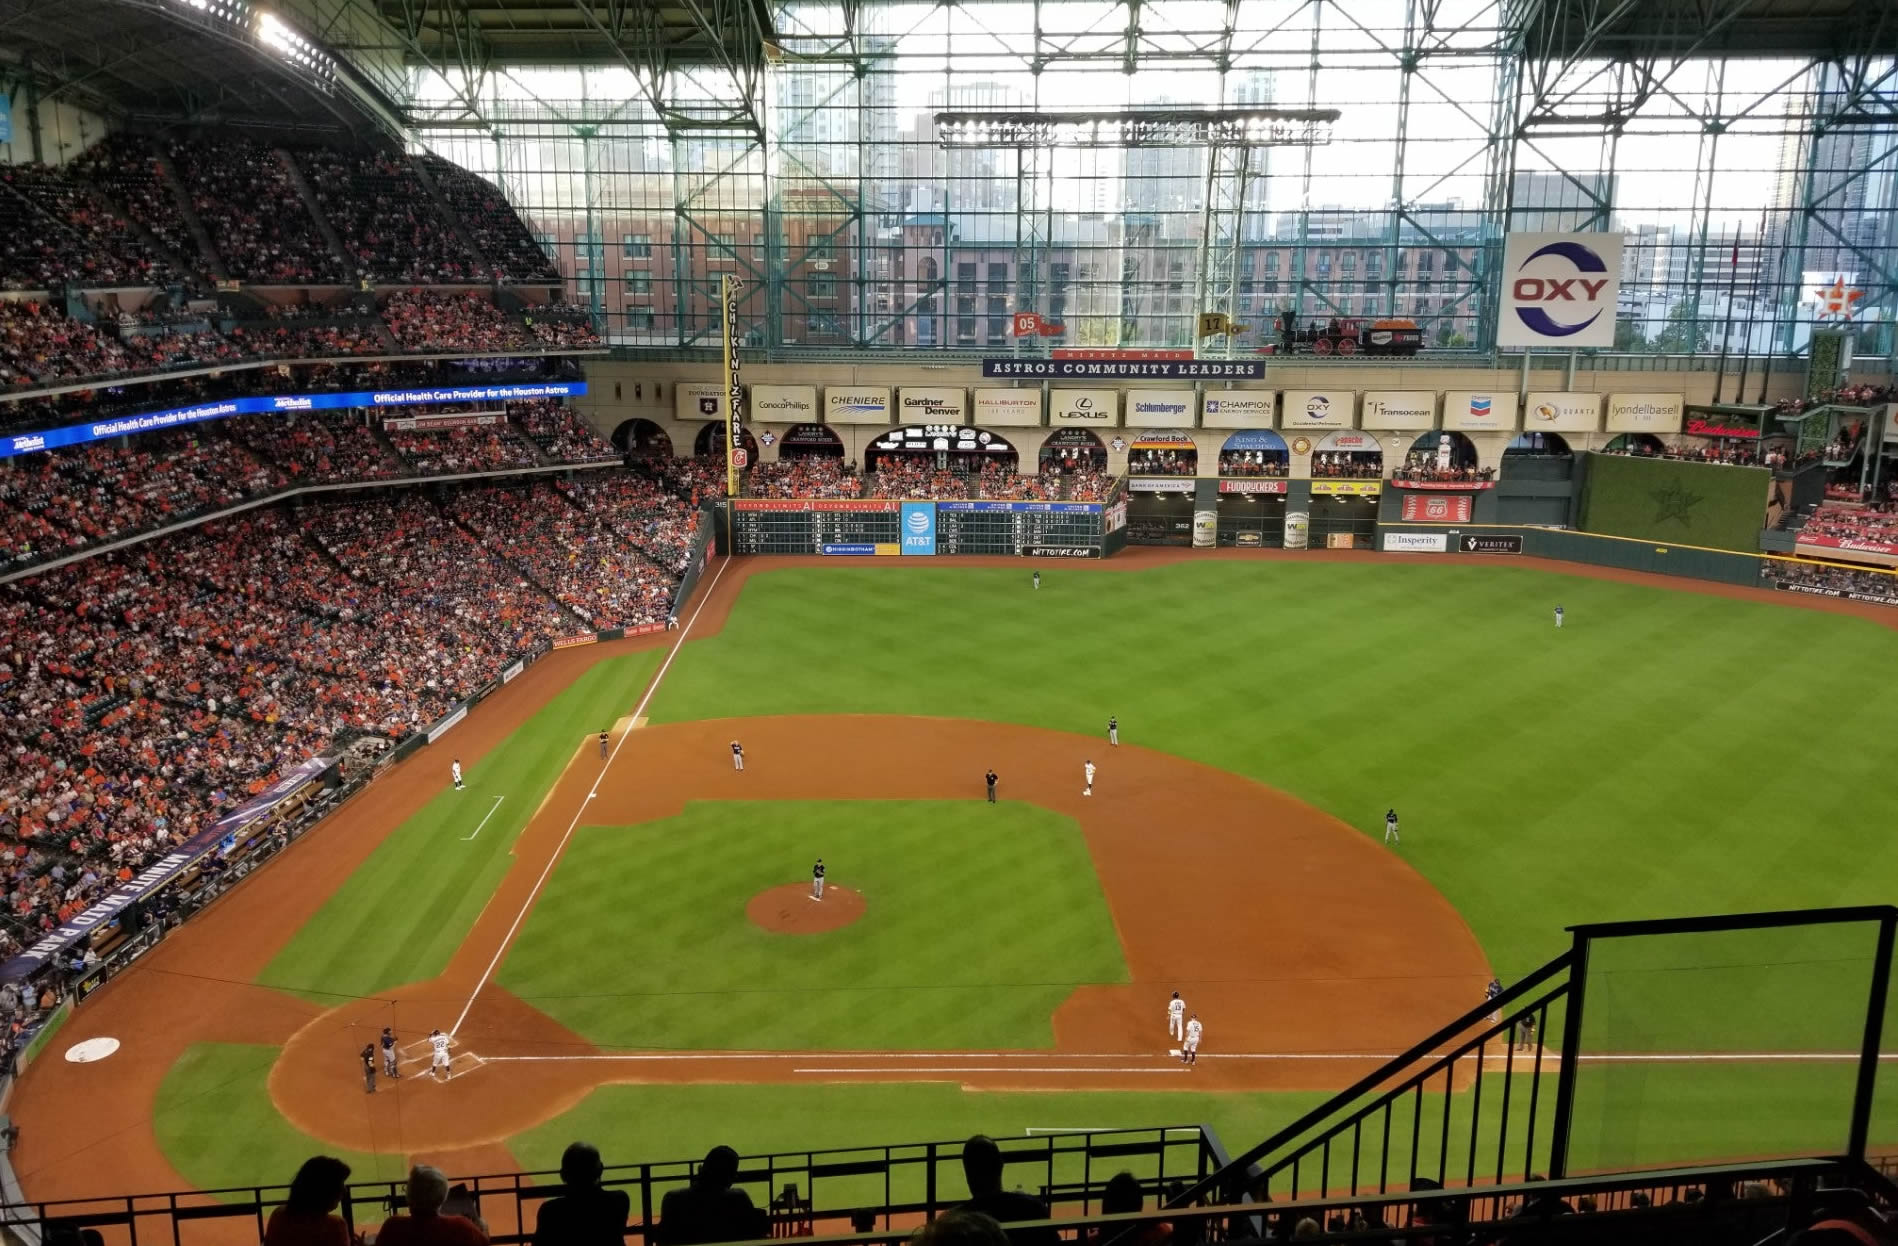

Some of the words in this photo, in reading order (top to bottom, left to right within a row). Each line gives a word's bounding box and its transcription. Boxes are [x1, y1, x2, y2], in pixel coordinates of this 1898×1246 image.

[1513, 278, 1609, 301] OXY
[1019, 317, 1035, 330] 05
[1205, 317, 1220, 331] 17
[730, 303, 740, 370] CHIKIN
[993, 363, 1055, 374] ASTROS
[1063, 364, 1170, 375] COMMUNITY
[1178, 364, 1255, 375] LEADERS
[731, 372, 741, 397] IZ
[374, 393, 404, 403] Official
[405, 392, 433, 402] Health
[434, 391, 452, 400] Care
[453, 390, 485, 400] Provider
[487, 389, 499, 398] for
[500, 388, 512, 397] the
[513, 387, 544, 397] Houston
[545, 386, 568, 396] Astros
[759, 401, 809, 411] ConocoPhillips
[831, 396, 885, 405] CHENIERE
[904, 397, 944, 406] Gardner
[1220, 400, 1271, 409] CHAMPION
[924, 406, 960, 416] Denver
[1135, 402, 1186, 414] Schlumberger
[1379, 408, 1430, 417] Transocean
[1612, 404, 1679, 417] lyondellbasell
[93, 424, 118, 436] Official
[118, 420, 138, 432] Health
[138, 418, 154, 429] Care
[154, 414, 178, 426] Provider
[178, 412, 186, 421] for
[186, 410, 196, 420] the
[196, 407, 220, 418] Houston
[219, 404, 236, 415] Astros
[1059, 411, 1108, 419] LEXUS
[731, 398, 741, 447] FARE
[1338, 436, 1363, 444] apache
[1226, 482, 1278, 492] FUDDRUCKERS
[906, 536, 932, 546] AT&T
[1398, 536, 1438, 545] Insperity
[1838, 538, 1892, 552] Budweiser
[1032, 548, 1090, 556] NITTOTIRE.COM
[1788, 585, 1840, 596] NITTOTIRE.COM
[553, 638, 576, 646] WELLS
[120, 853, 191, 893] MINUTE
[71, 894, 131, 926] MAID
[20, 927, 81, 960] PARK
[436, 1041, 444, 1050] 22
